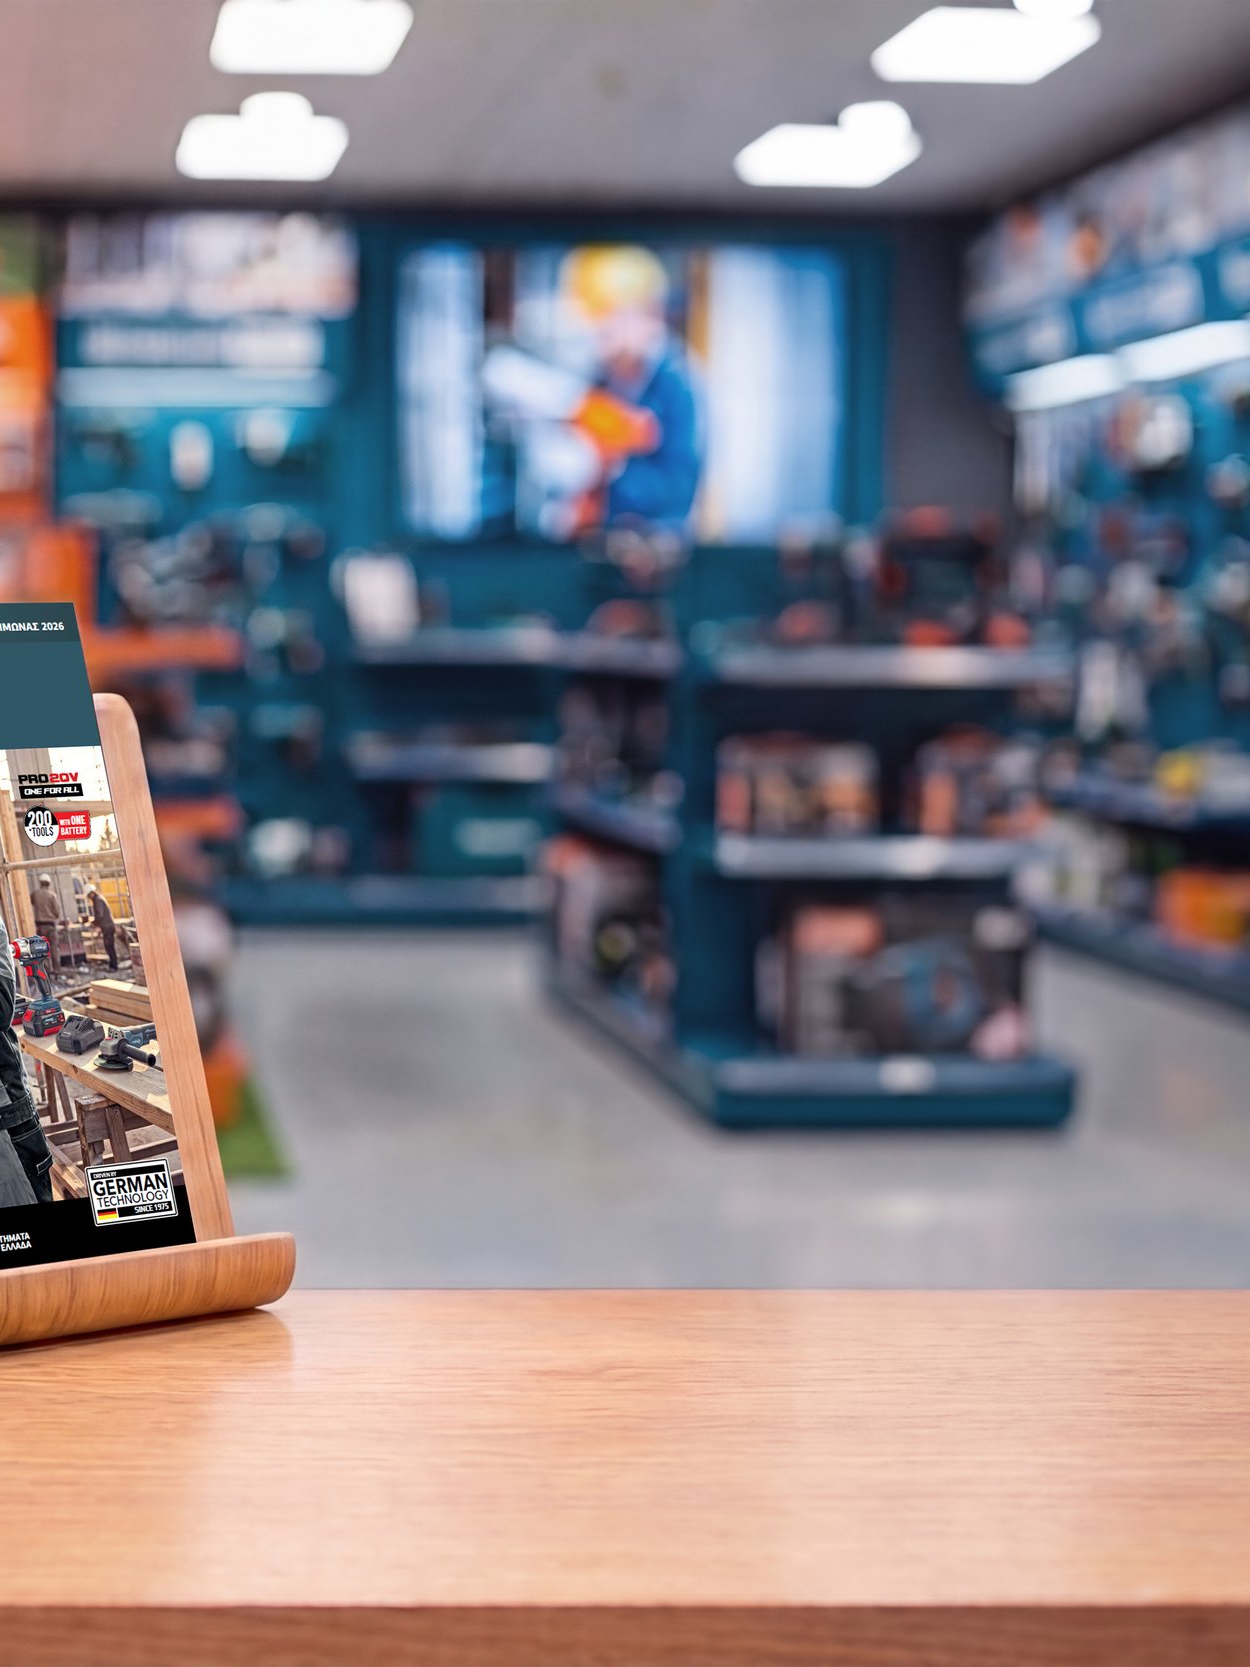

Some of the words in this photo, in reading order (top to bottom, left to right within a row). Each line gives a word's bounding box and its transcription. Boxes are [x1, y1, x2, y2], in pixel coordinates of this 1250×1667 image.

[41, 622, 64, 631] 2026
[27, 811, 52, 827] 200
[71, 815, 86, 825] ONE
[61, 826, 87, 835] BATTERY
[93, 1173, 168, 1196] GERMAN
[97, 1189, 169, 1207] TECHNOLOGY
[134, 1204, 154, 1213] SINCE
[154, 1202, 169, 1210] 1975
[1, 1241, 32, 1252] ΕΛΛΑΔΑ
